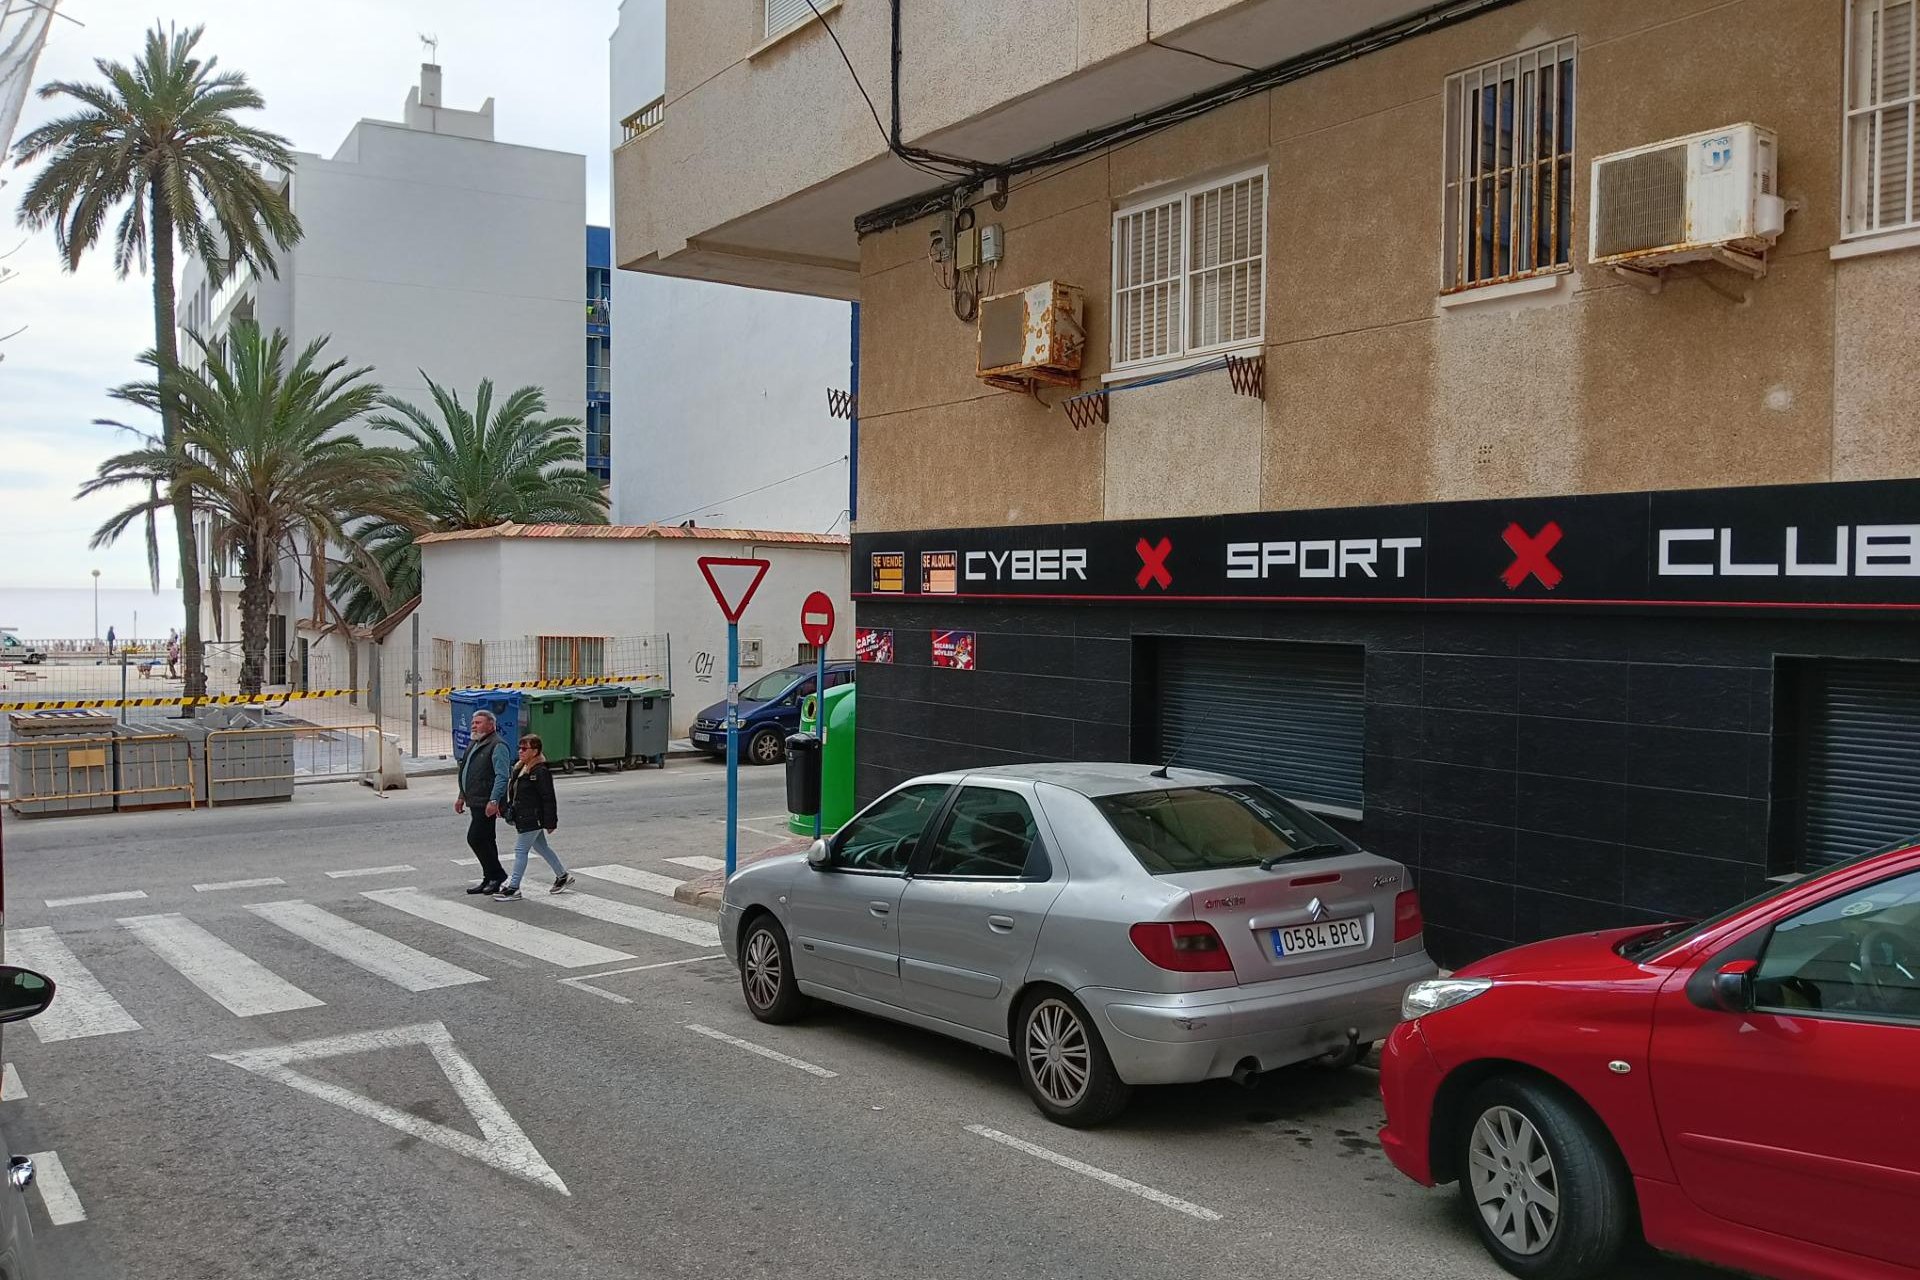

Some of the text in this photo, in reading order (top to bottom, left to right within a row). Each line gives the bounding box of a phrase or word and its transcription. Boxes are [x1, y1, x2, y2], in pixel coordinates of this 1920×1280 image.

[873, 555, 903, 567] SE VENDE
[922, 554, 955, 568] SE ALQUILA
[965, 549, 1087, 580] CYBER
[1227, 537, 1422, 578] SPORT
[1658, 524, 1920, 576] CLUB
[1283, 926, 1327, 951] 0584
[1329, 922, 1360, 945] BPC
